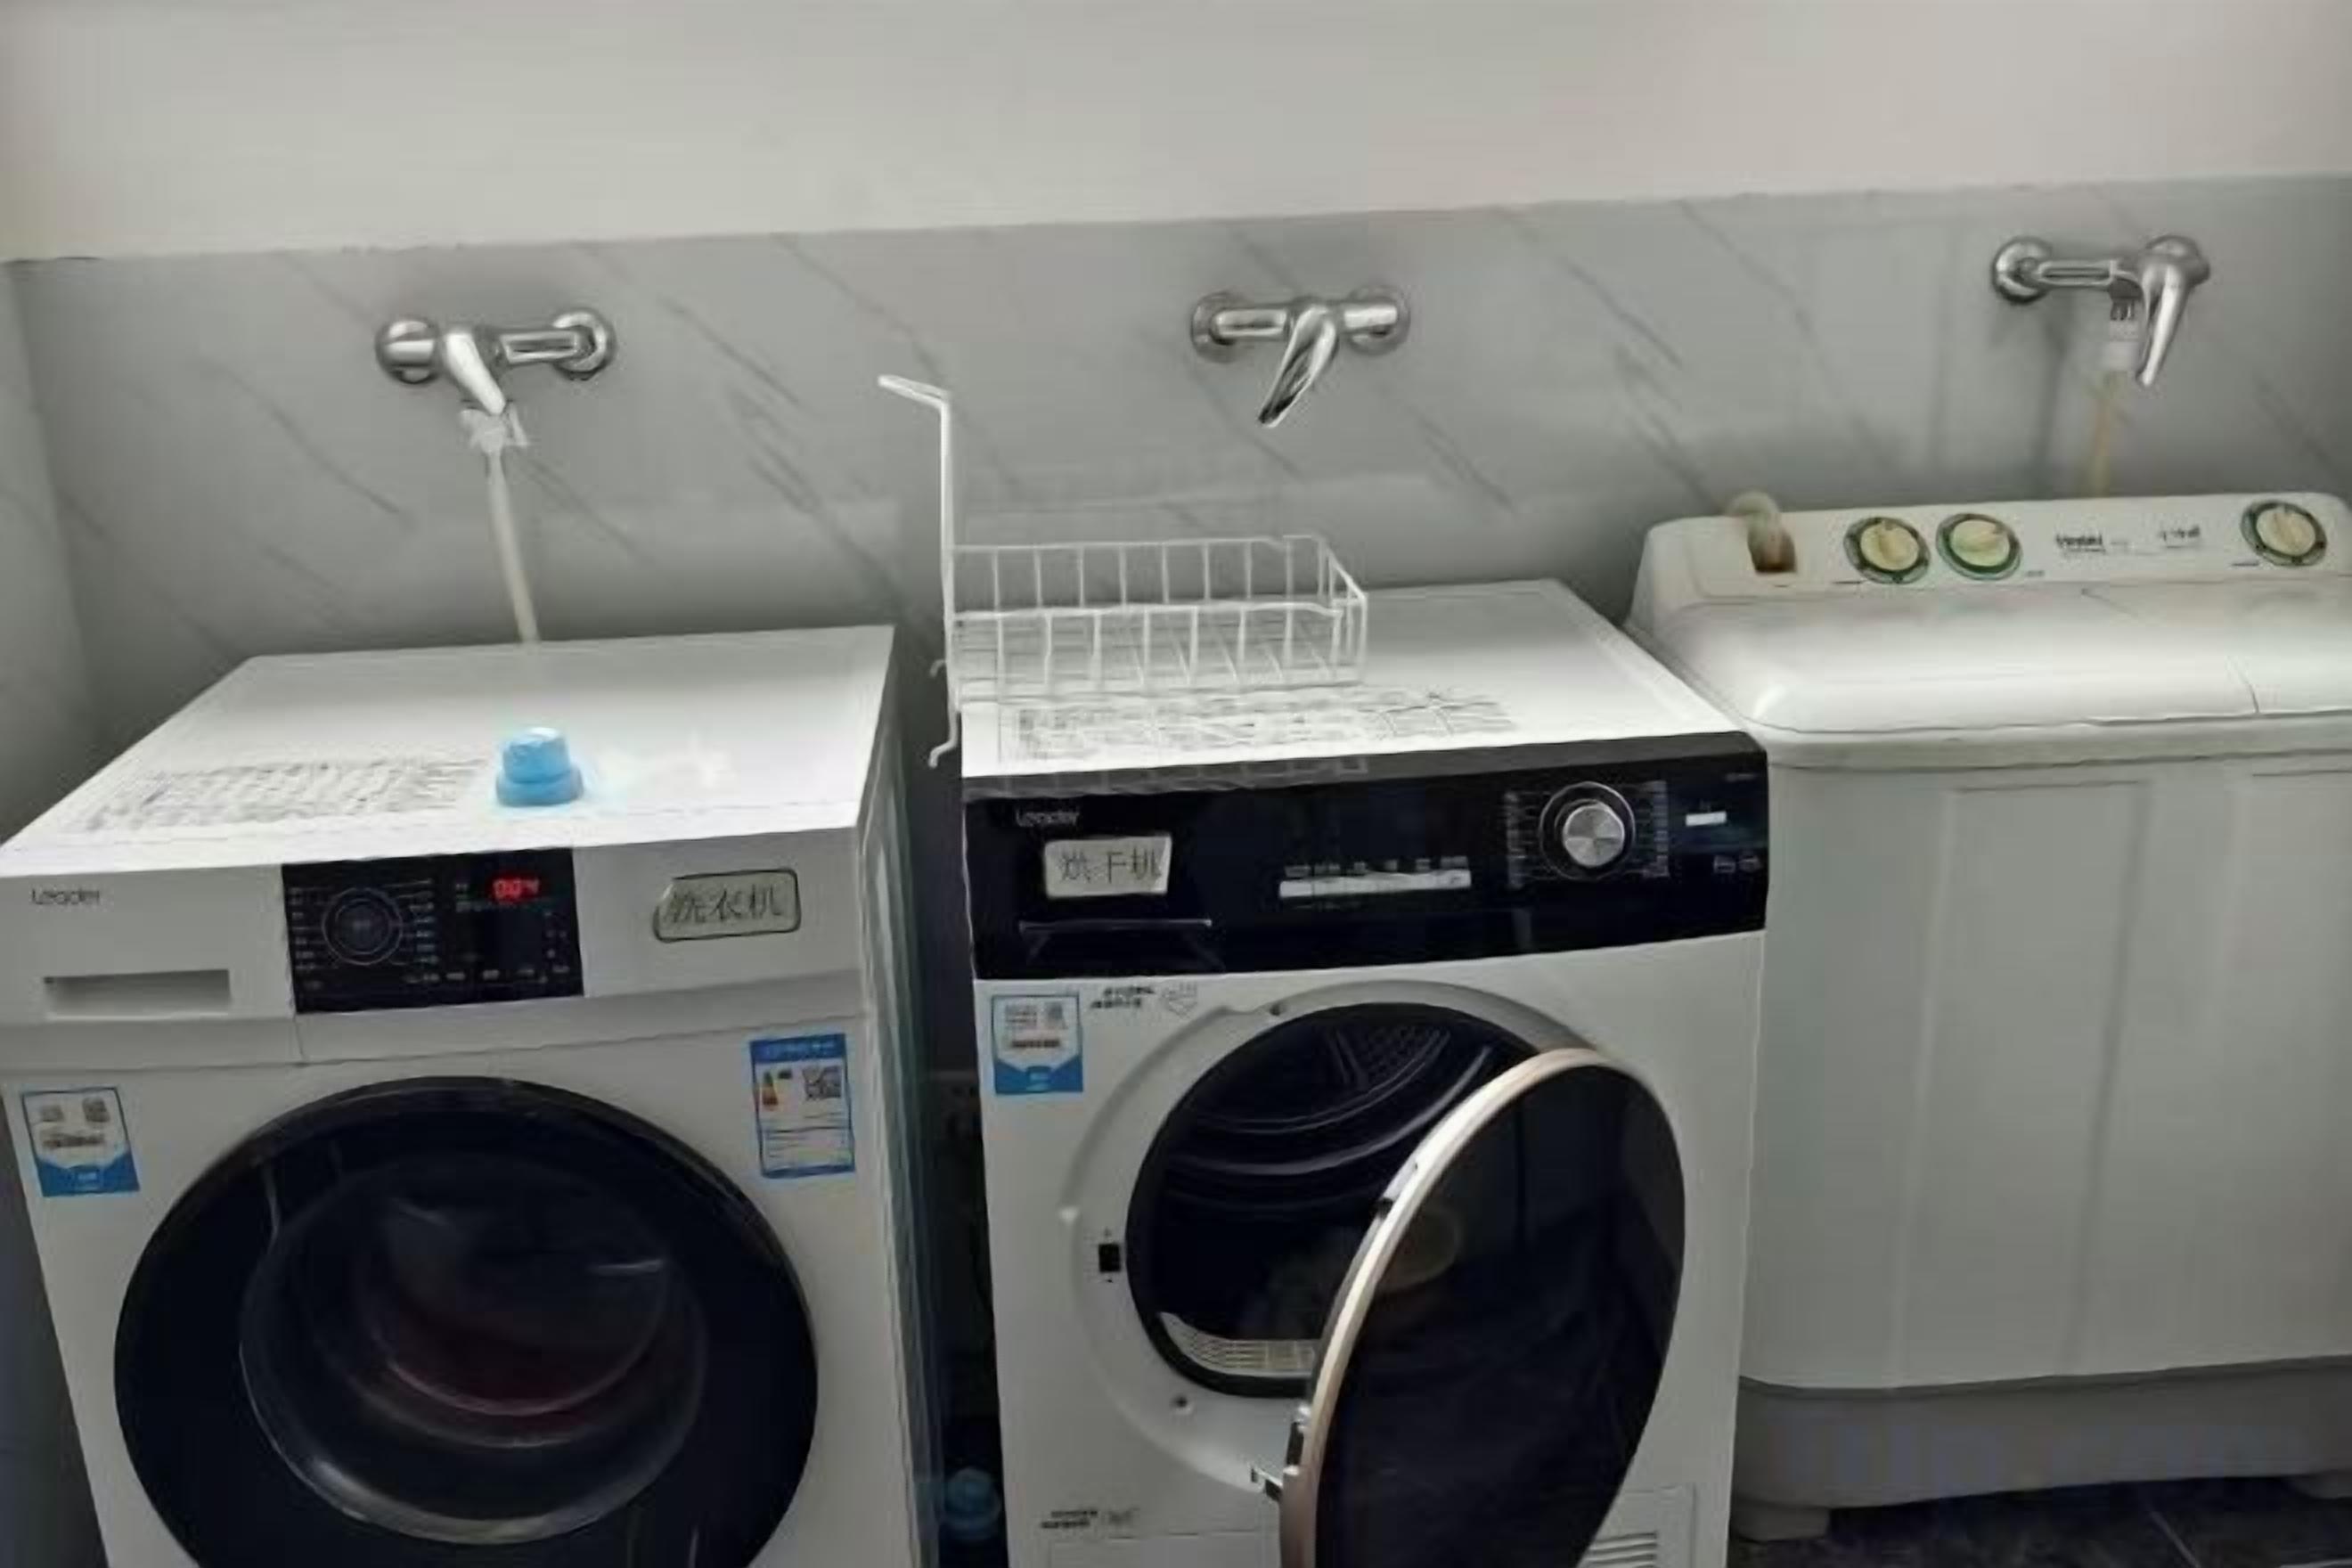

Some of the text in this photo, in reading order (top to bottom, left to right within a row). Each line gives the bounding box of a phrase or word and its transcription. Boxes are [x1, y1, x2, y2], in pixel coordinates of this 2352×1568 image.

[1058, 846, 1162, 884] 烘干机
[663, 884, 783, 924] 洗衣机
